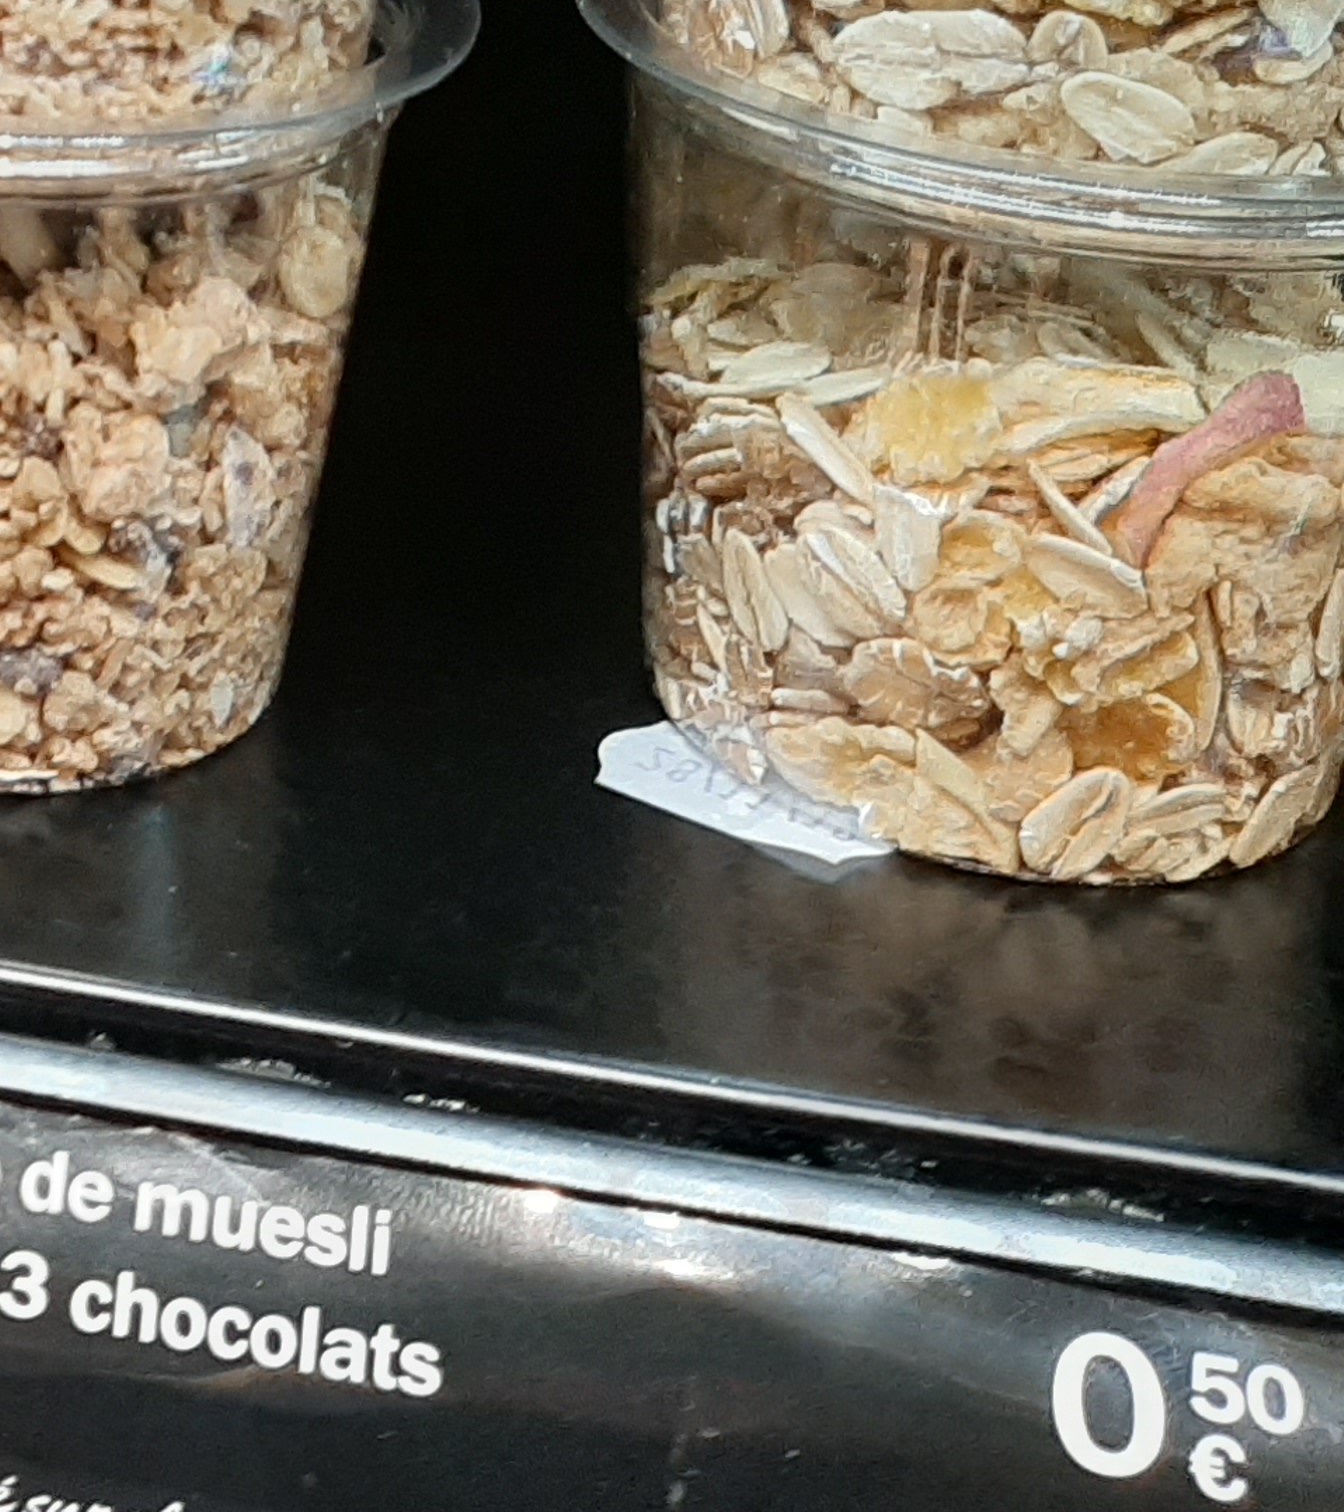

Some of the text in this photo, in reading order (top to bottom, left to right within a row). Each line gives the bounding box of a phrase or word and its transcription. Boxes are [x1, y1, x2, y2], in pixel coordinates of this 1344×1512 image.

[19, 1150, 113, 1223] de
[134, 1180, 393, 1276] muesli
[69, 1271, 444, 1398] chocolats
[1053, 1332, 1304, 1503] 0 50 €
